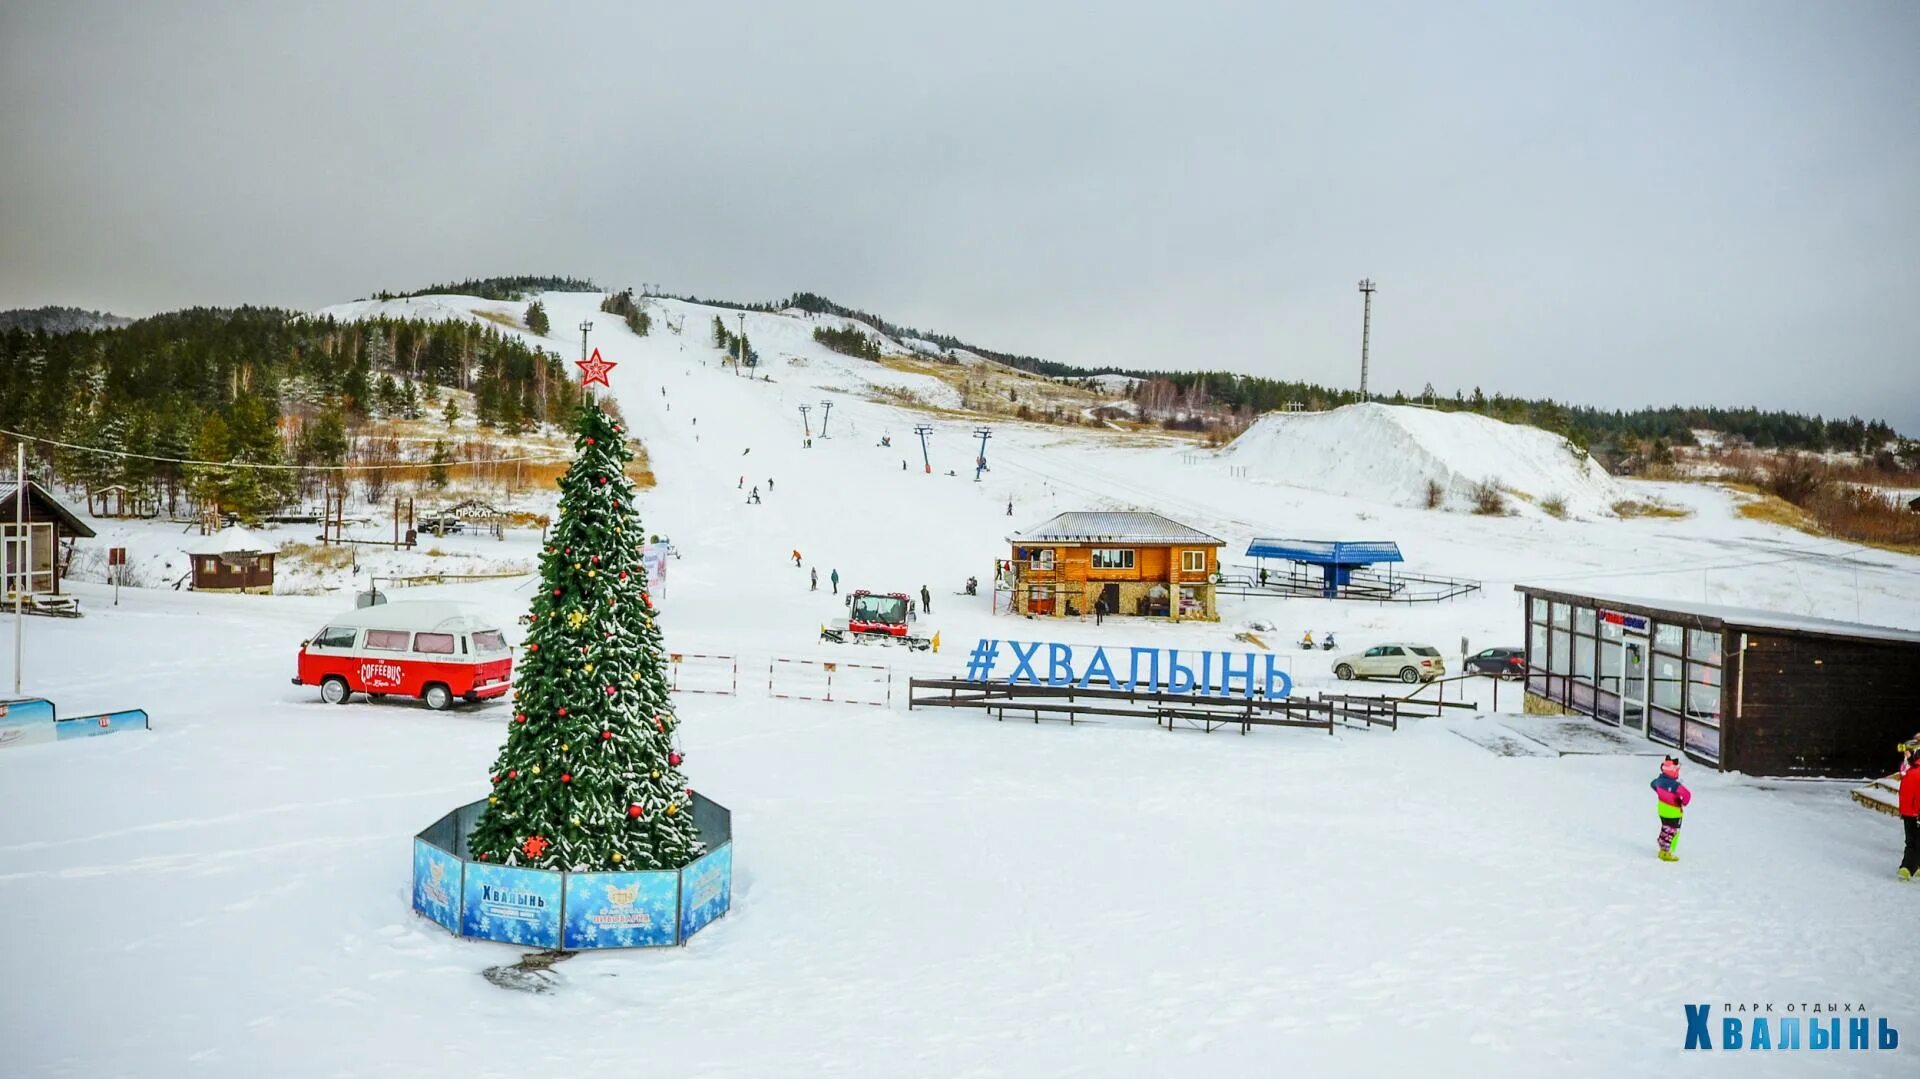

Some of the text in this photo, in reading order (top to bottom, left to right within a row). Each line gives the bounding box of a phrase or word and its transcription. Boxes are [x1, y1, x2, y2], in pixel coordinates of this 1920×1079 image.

[455, 508, 493, 518] ПРОКАТ
[361, 663, 401, 685] COFFEEBUS
[966, 639, 1293, 699] #ХВАЛЫНЬ
